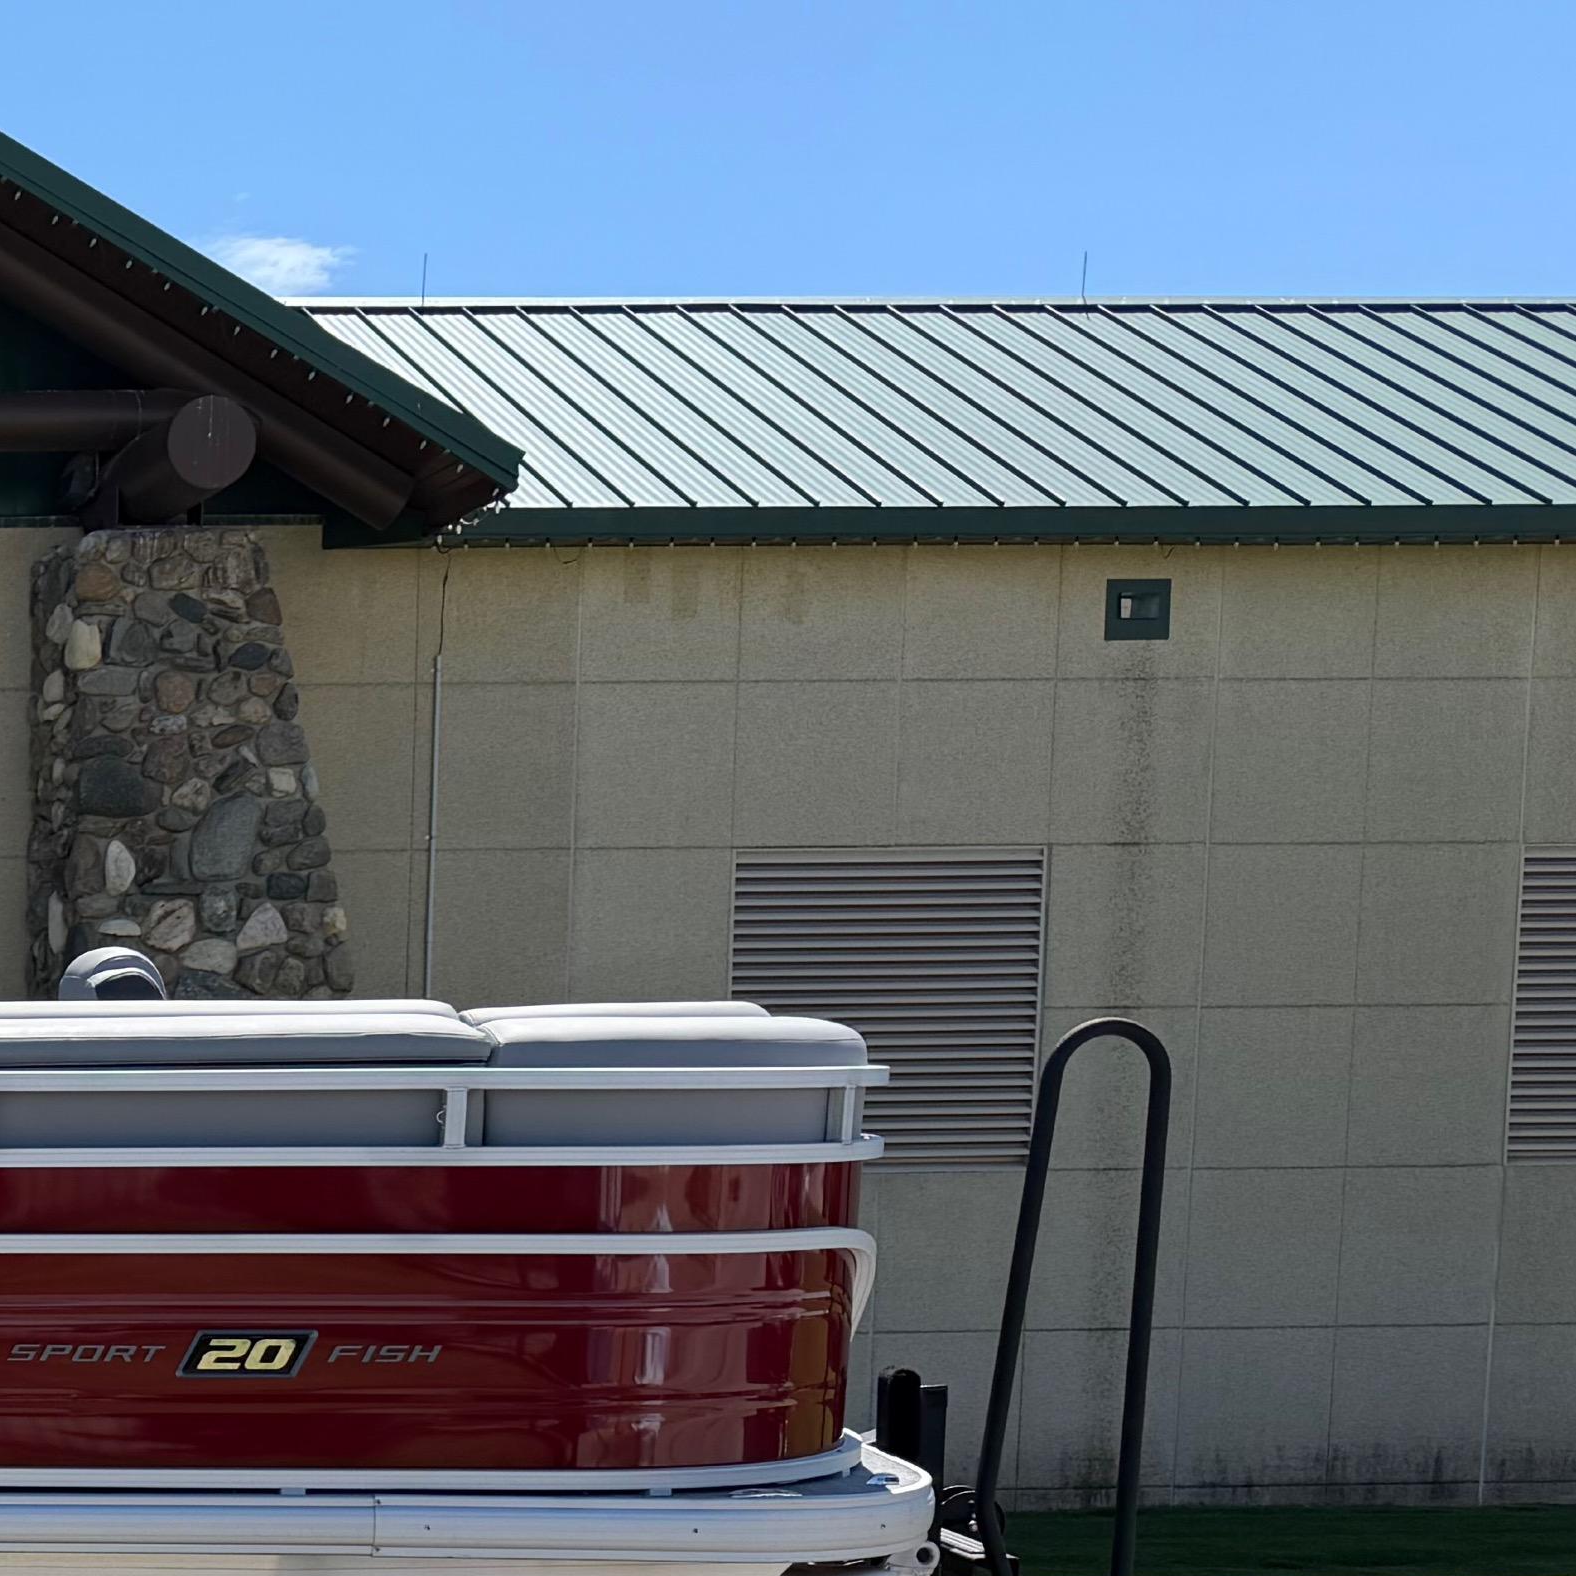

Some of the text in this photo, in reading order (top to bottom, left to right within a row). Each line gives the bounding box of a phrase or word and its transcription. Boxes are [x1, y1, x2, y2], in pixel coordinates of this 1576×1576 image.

[6, 1338, 443, 1370] SPORT 20 FISH
